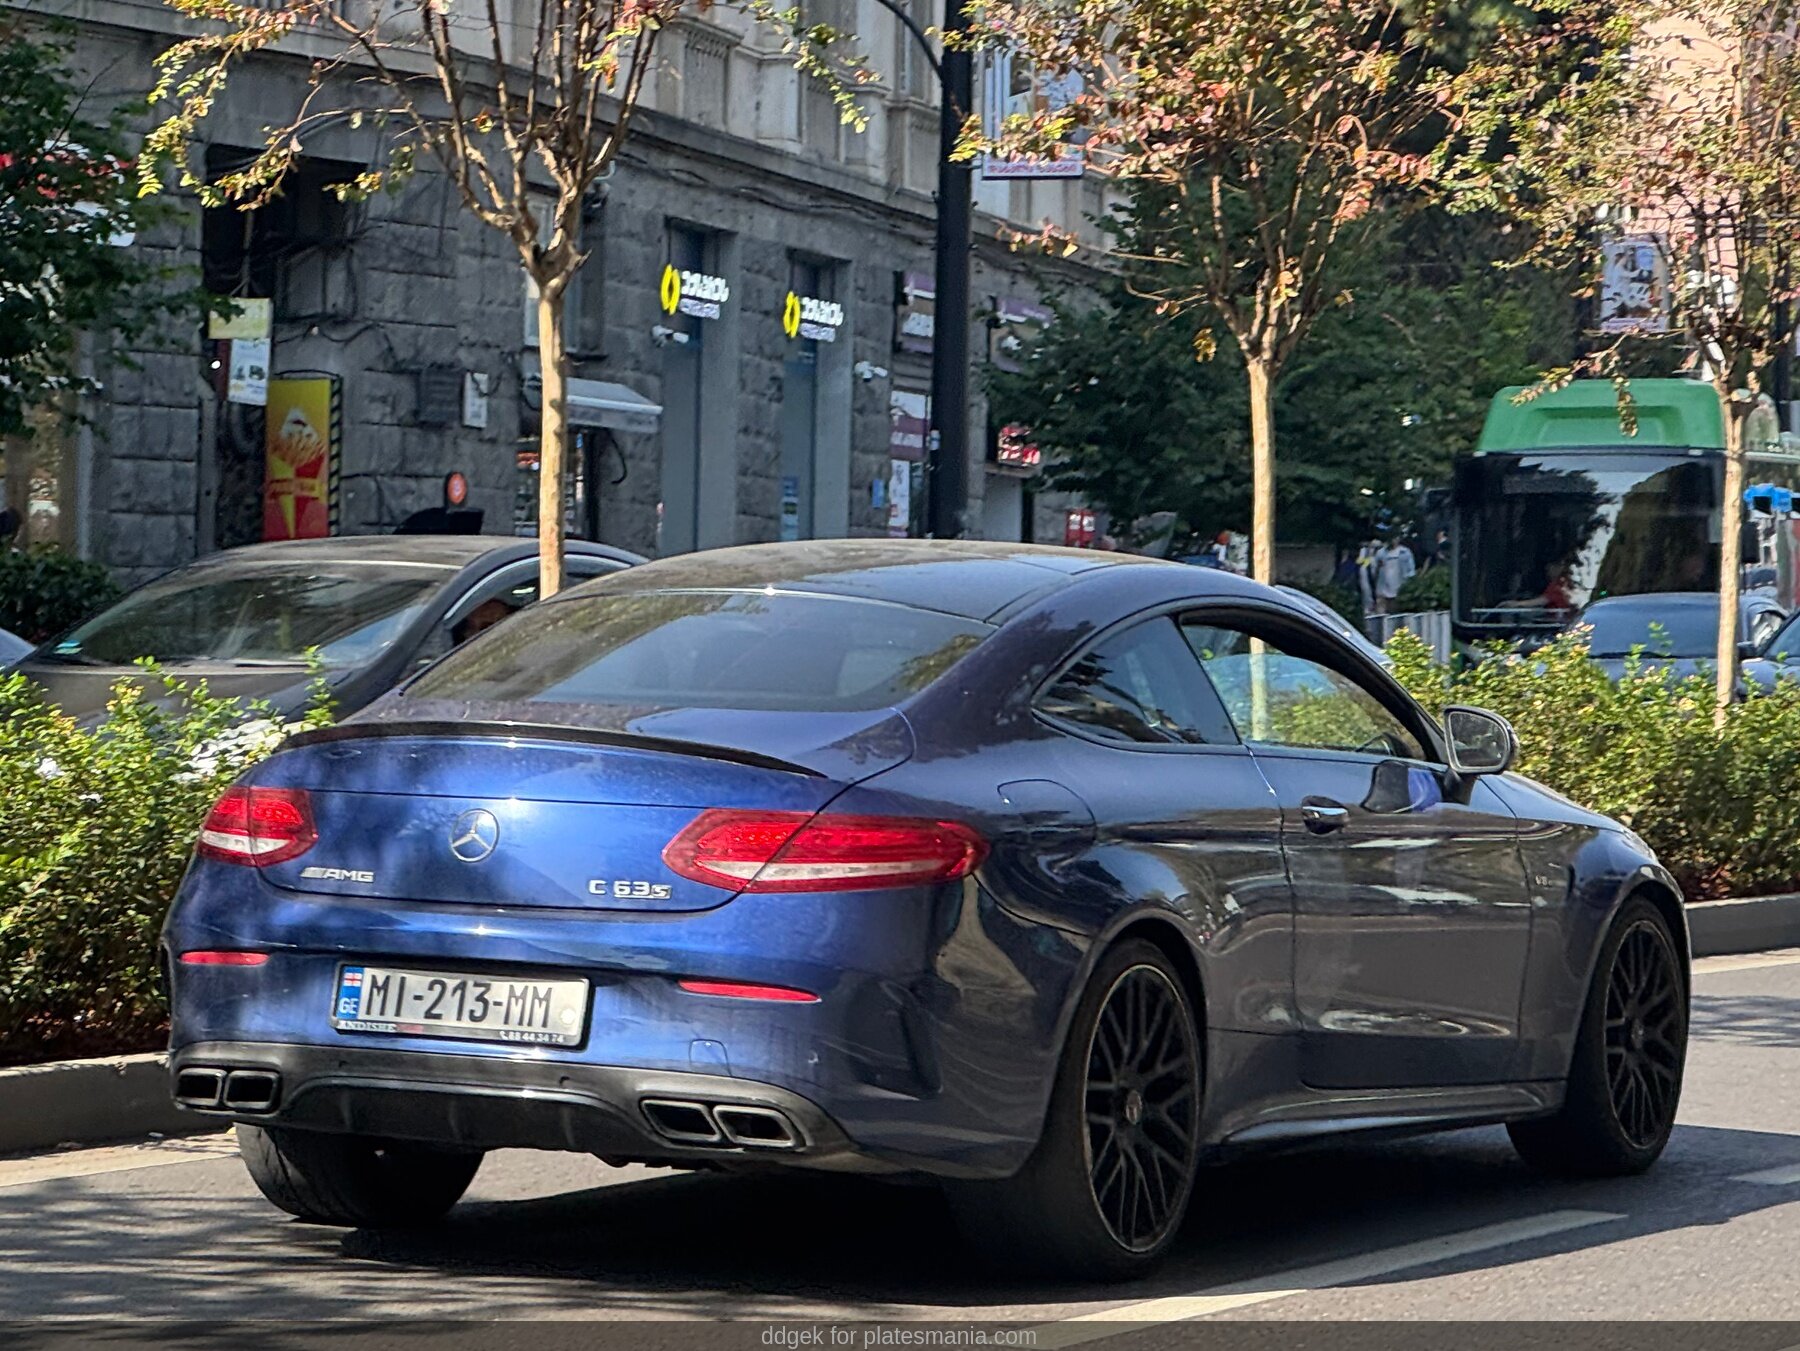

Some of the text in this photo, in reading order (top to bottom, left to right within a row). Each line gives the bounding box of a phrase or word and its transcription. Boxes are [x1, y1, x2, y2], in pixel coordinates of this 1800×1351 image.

[322, 868, 375, 883] AMG
[588, 879, 608, 895] C
[338, 997, 358, 1015] GE
[365, 974, 553, 1028] MI-213-MM
